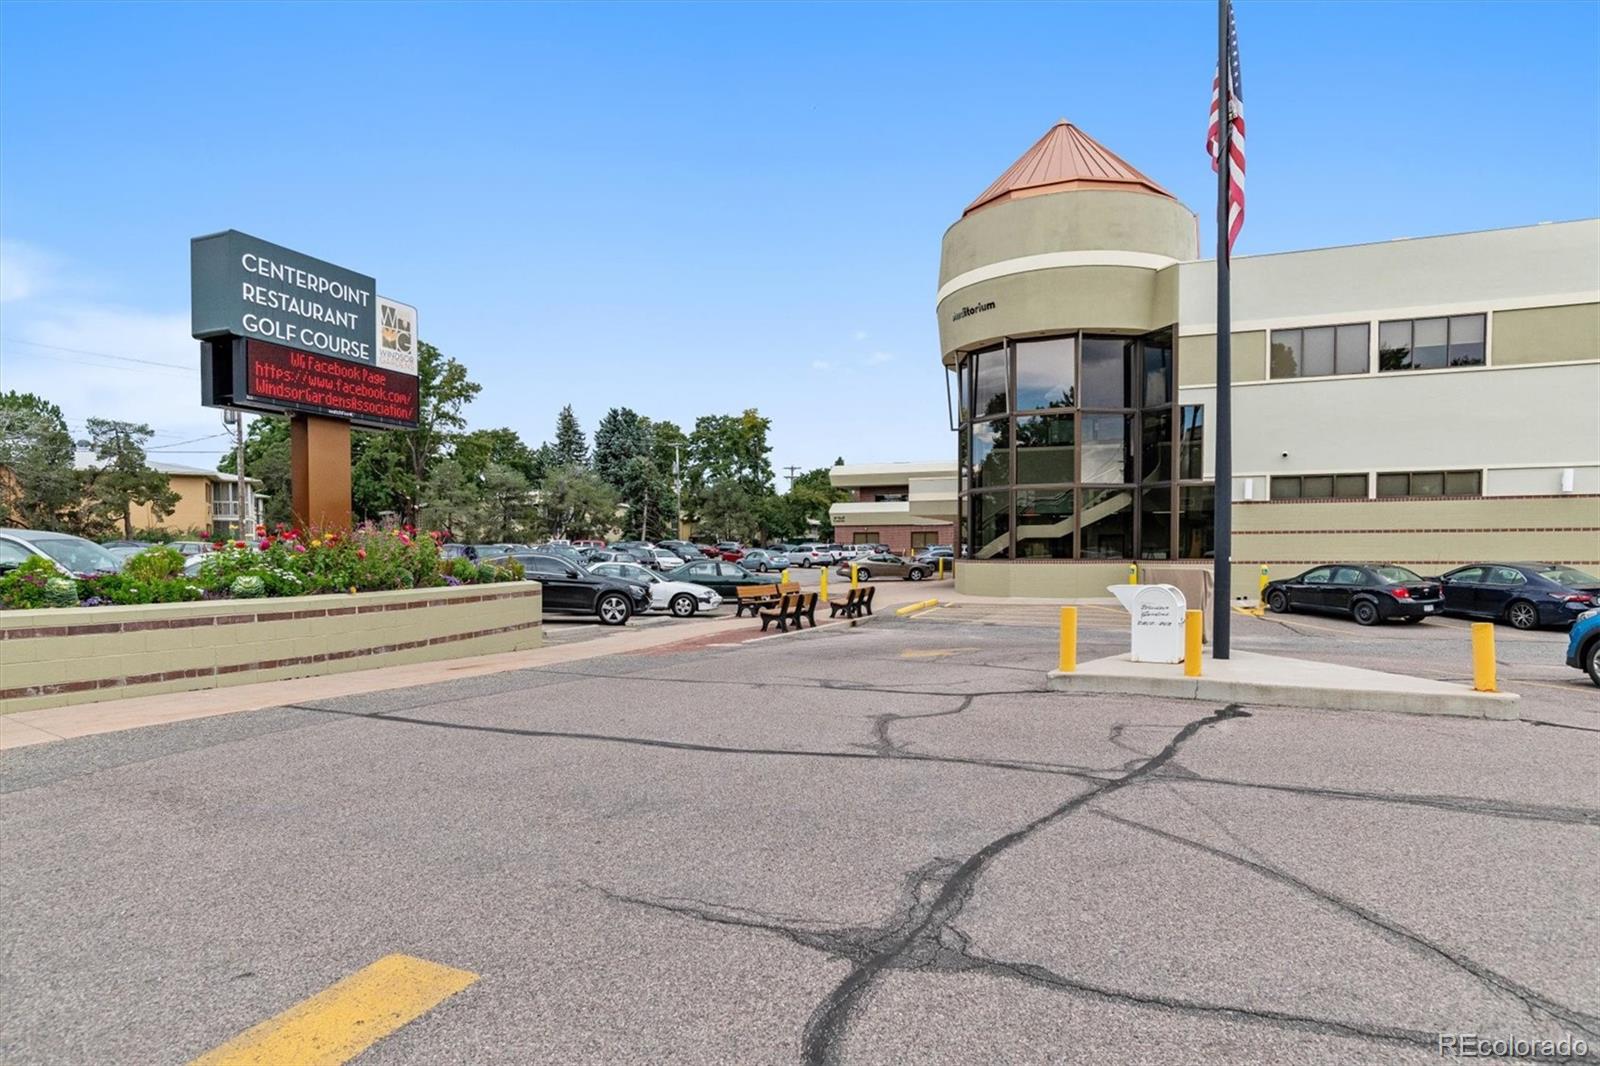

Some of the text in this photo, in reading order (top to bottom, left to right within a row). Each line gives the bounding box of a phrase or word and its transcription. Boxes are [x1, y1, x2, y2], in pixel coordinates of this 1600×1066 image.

[241, 253, 370, 307] CENTERPOINT
[242, 283, 358, 330] RESTAURANT
[242, 313, 370, 360] GOLF COURSE
[290, 352, 305, 369] WG
[307, 356, 361, 380] Facebook
[362, 367, 386, 386] Page
